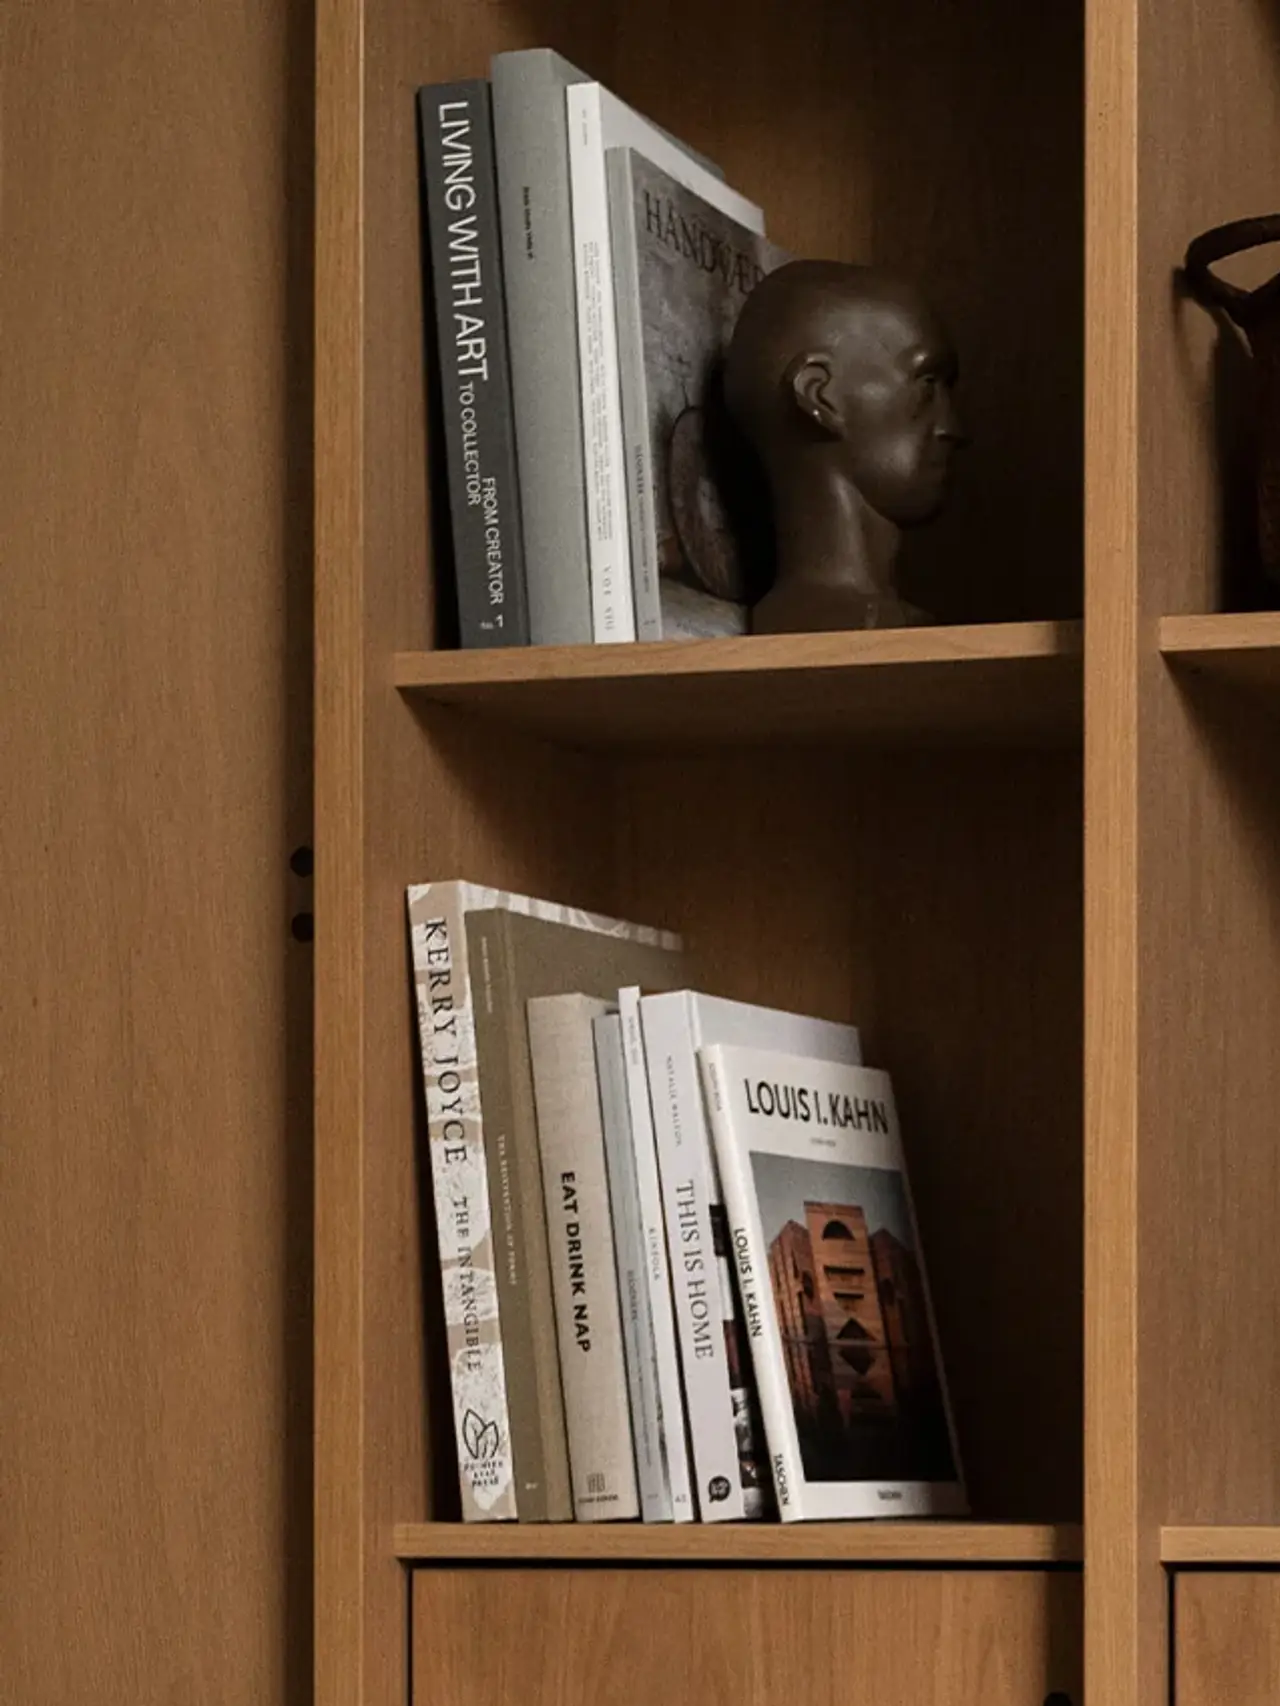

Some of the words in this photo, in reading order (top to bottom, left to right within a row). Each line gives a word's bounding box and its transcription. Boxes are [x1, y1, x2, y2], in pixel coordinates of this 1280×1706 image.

[439, 101, 477, 211] LIVING
[448, 215, 483, 307] WITH
[453, 313, 489, 381] ART
[459, 381, 474, 405] TO
[460, 408, 481, 506] COLLECTOR
[482, 476, 499, 525] FROM
[485, 527, 504, 605] CREATOR
[425, 919, 457, 1040] KERRY
[433, 1056, 467, 1165] JOYCE
[745, 1078, 811, 1122] LOUIS
[813, 1090, 829, 1125] I.
[828, 1092, 889, 1134] KAHN
[453, 1196, 470, 1237] THE
[560, 1170, 580, 1216] EAT
[675, 1179, 700, 1244] THIS
[565, 1222, 586, 1297] DRINK
[683, 1249, 704, 1281] IS
[734, 1227, 752, 1274] LOUIS
[745, 1293, 762, 1338] KAHN
[457, 1245, 483, 1372] INTANGIBLE
[573, 1303, 592, 1353] NAP
[688, 1284, 714, 1360] HOME
[773, 1453, 789, 1507] TASCHEN
